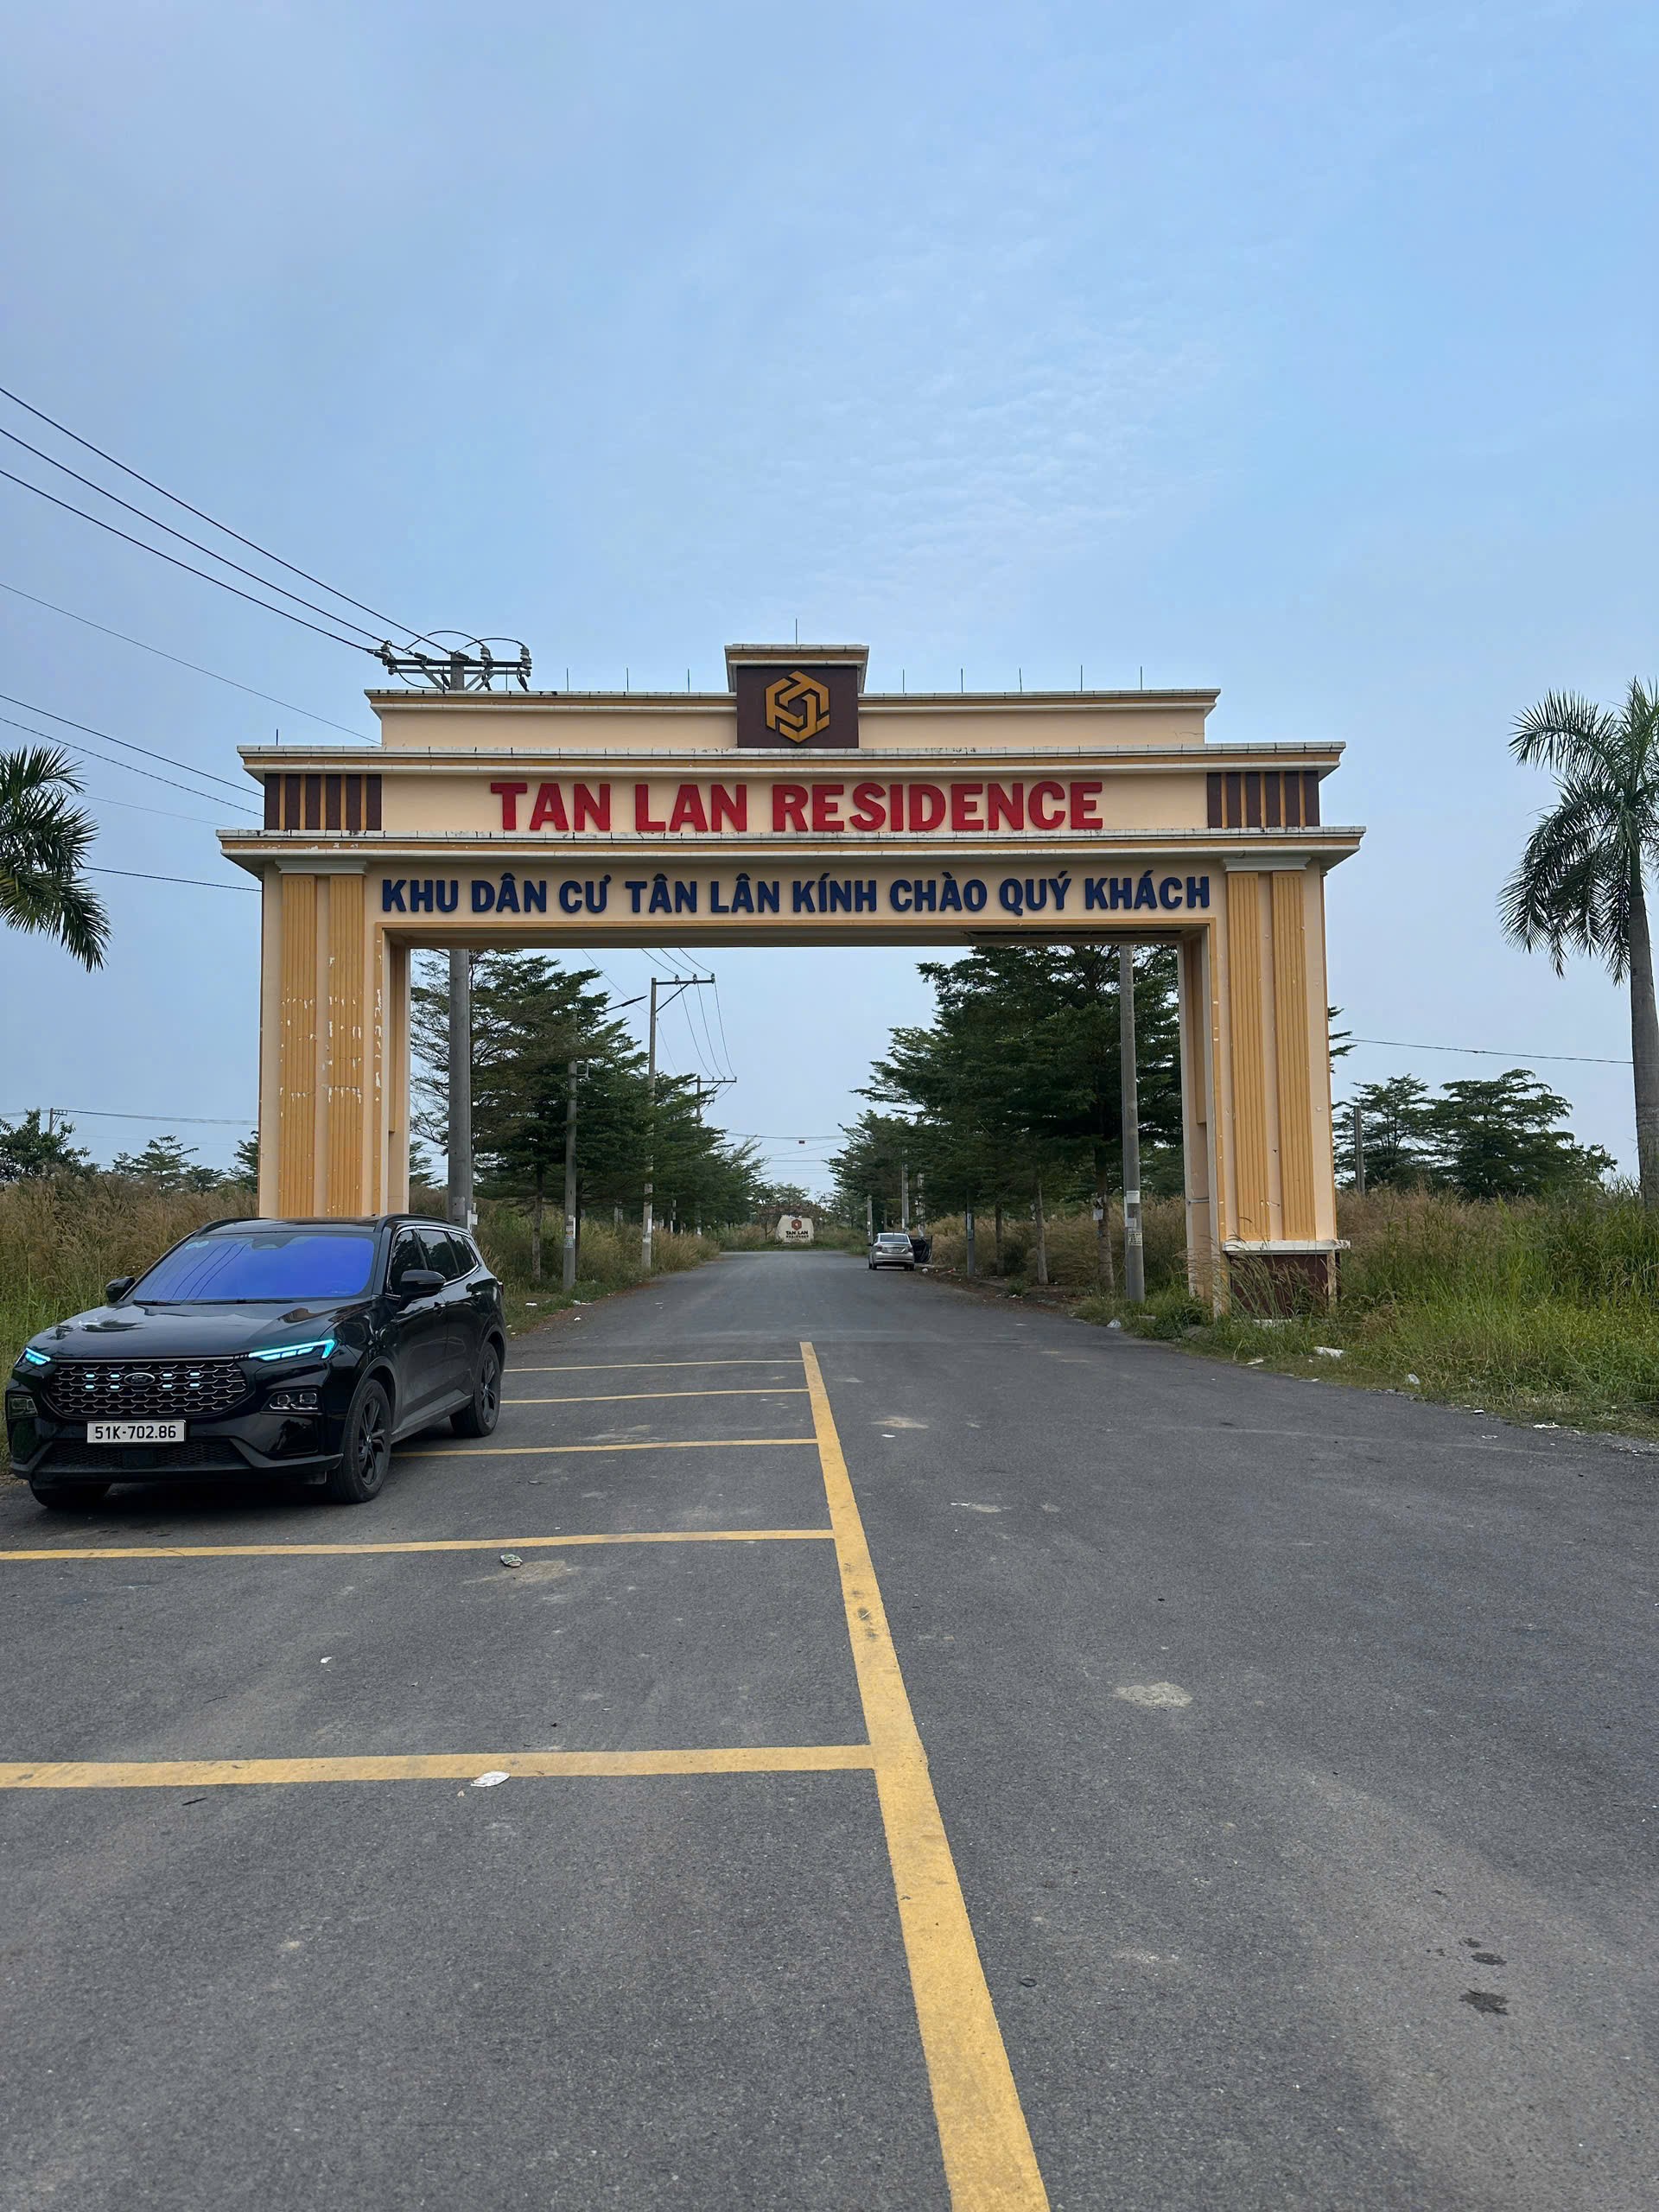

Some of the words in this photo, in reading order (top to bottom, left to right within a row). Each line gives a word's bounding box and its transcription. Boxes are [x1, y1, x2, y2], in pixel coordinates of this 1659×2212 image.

[490, 782, 611, 830] TAN
[634, 783, 747, 831] LAN
[772, 780, 1103, 831] RESIDENCE
[382, 879, 459, 912] KHU
[471, 873, 547, 913] DÂN
[559, 874, 611, 913] CƯ
[625, 873, 697, 913] TÂN
[710, 873, 780, 913] LÂN
[792, 872, 877, 913] KÍNH
[889, 872, 988, 912] CHÀO
[999, 870, 1071, 916] QUÝ
[1084, 869, 1210, 910] KHÁCH
[95, 1425, 176, 1440] 51K-702.86
